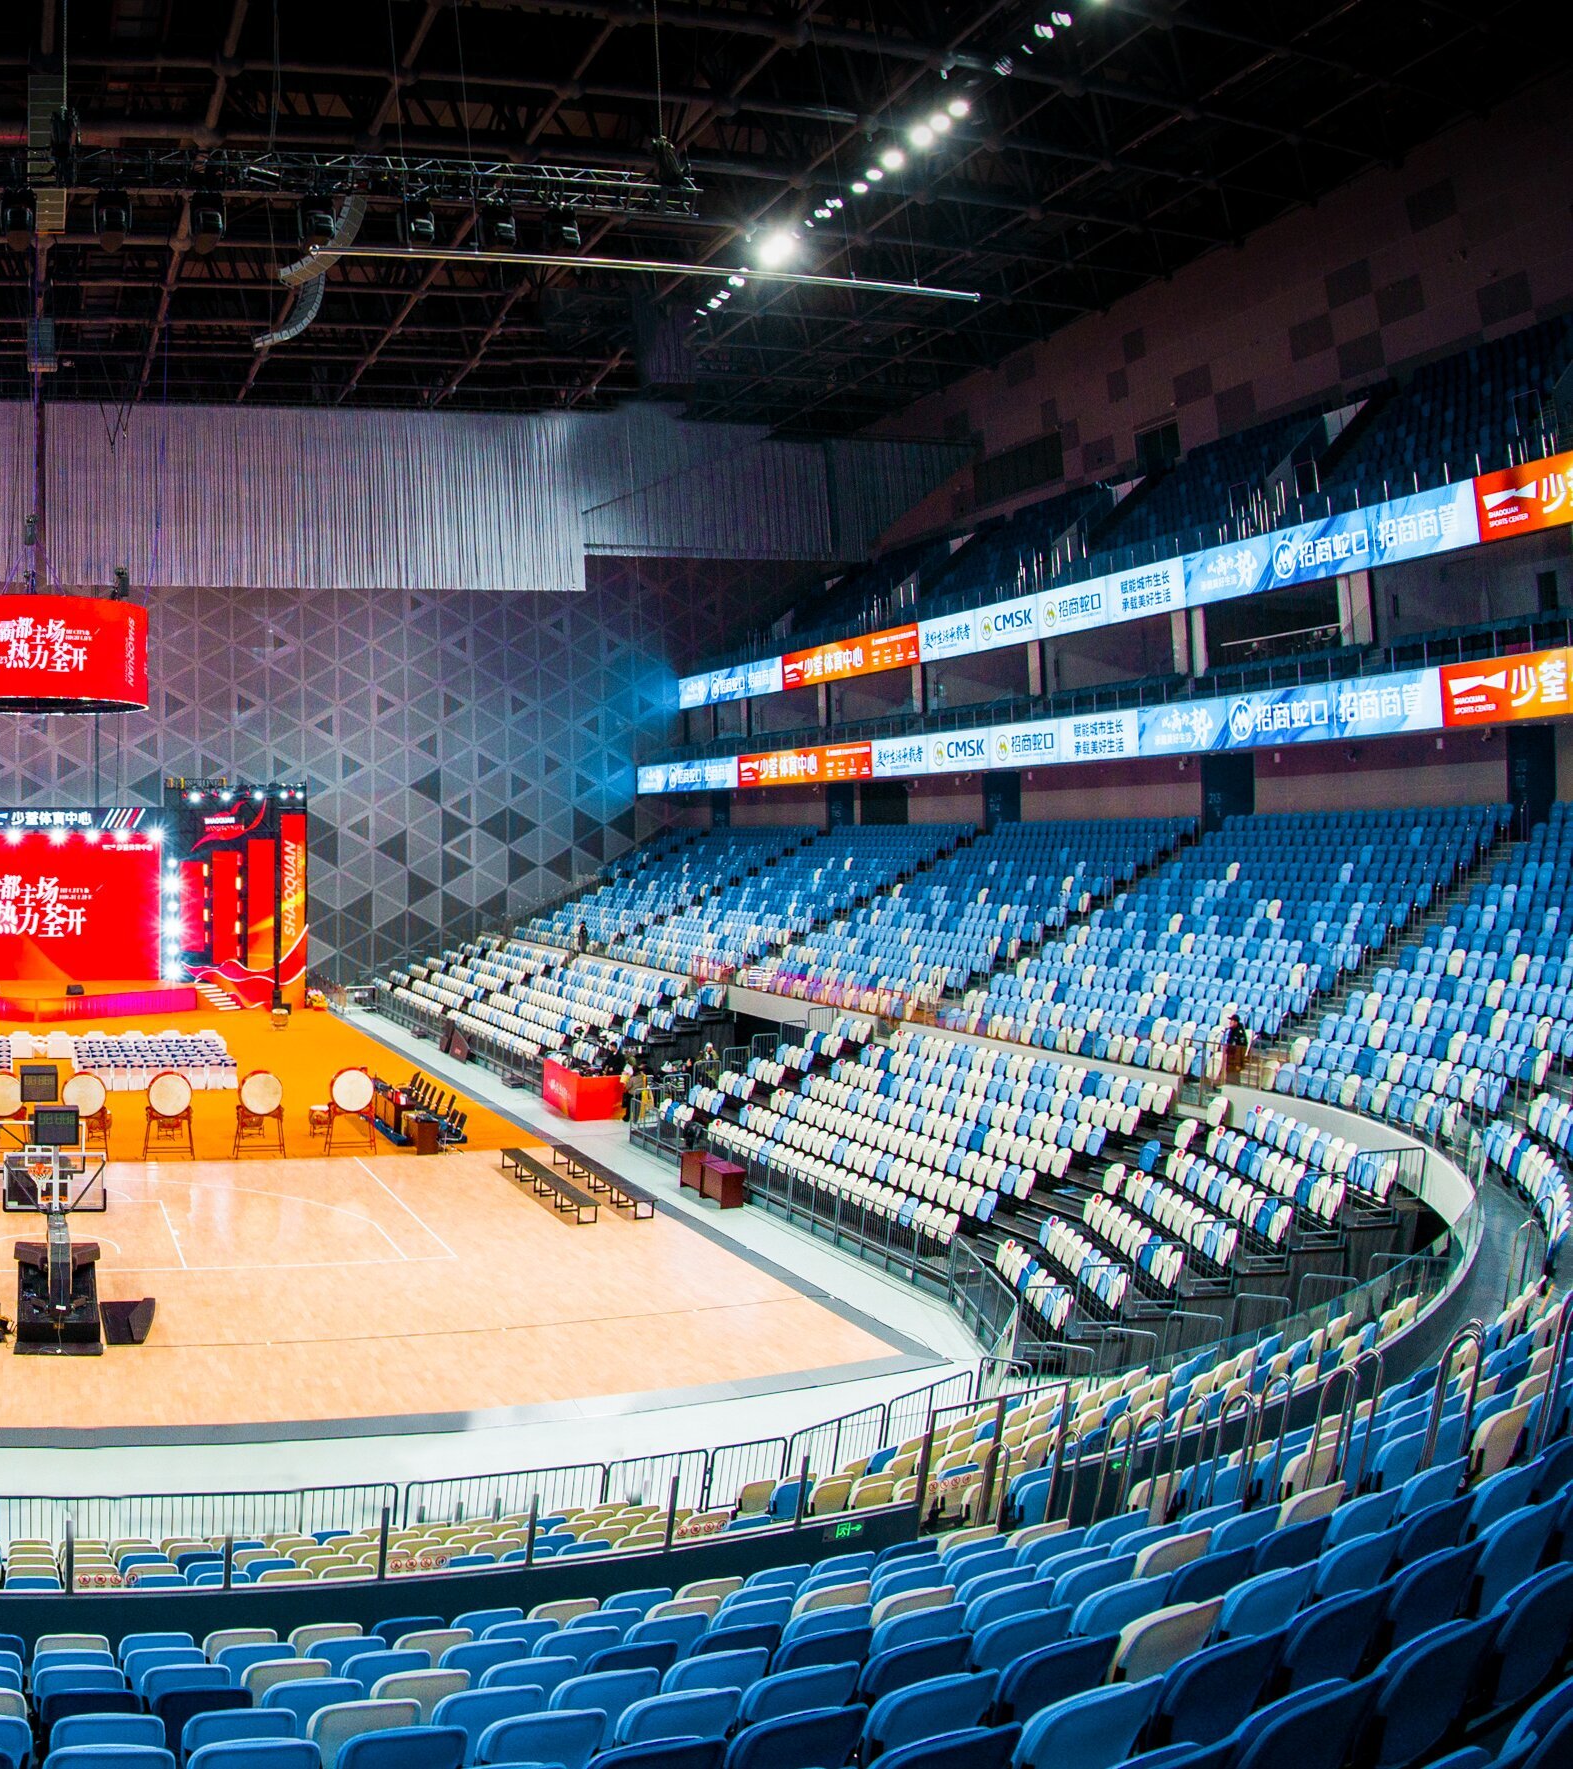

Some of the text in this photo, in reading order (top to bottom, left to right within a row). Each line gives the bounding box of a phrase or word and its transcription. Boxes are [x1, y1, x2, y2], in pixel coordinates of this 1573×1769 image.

[1298, 502, 1459, 569] 招商蛇口 招商商管
[1120, 569, 1170, 594] 赋能城市生长
[1058, 592, 1102, 619] 招商蛇口
[1121, 587, 1172, 613] 承载美好生活
[994, 608, 1033, 632] CMSK
[1255, 683, 1423, 732] 招商蛇口 招商商管
[946, 738, 985, 759] CMSK
[1011, 732, 1054, 753] 招商蛇口
[284, 840, 296, 937] SHAOQUAN
